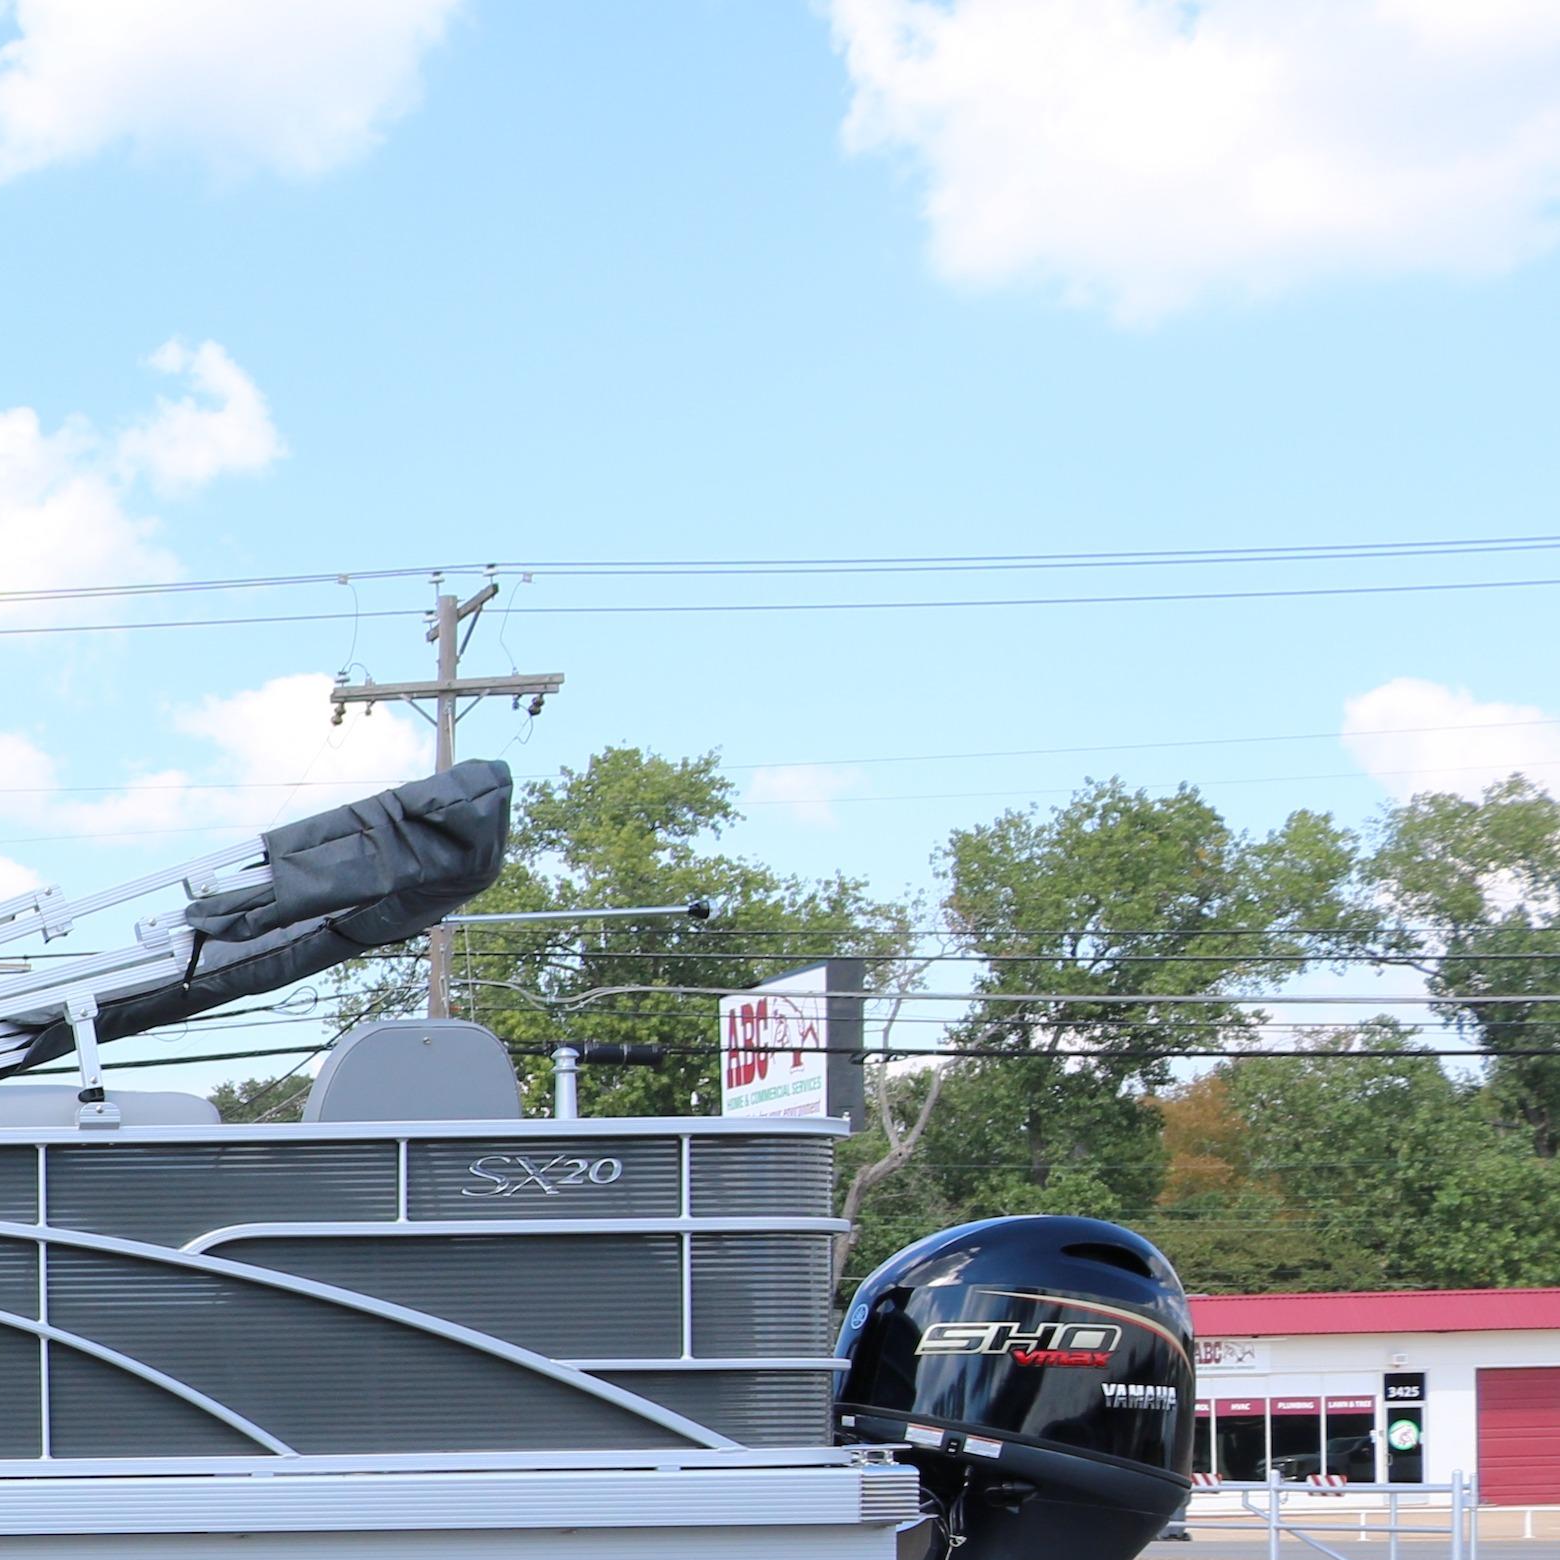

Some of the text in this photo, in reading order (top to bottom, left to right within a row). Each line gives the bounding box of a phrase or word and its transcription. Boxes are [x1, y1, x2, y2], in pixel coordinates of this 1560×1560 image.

[727, 997, 768, 1090] ABC
[792, 1076, 822, 1096] SERVICES
[914, 1322, 1123, 1356] SHO
[1194, 1341, 1222, 1364] ABC
[1101, 1383, 1177, 1411] YAMAHA
[1387, 1385, 1420, 1399] 3425
[1230, 1402, 1252, 1411] HVAC
[1277, 1401, 1315, 1410] PLUMBING
[1327, 1401, 1347, 1409] LAWN
[1355, 1399, 1372, 1408] TREE
